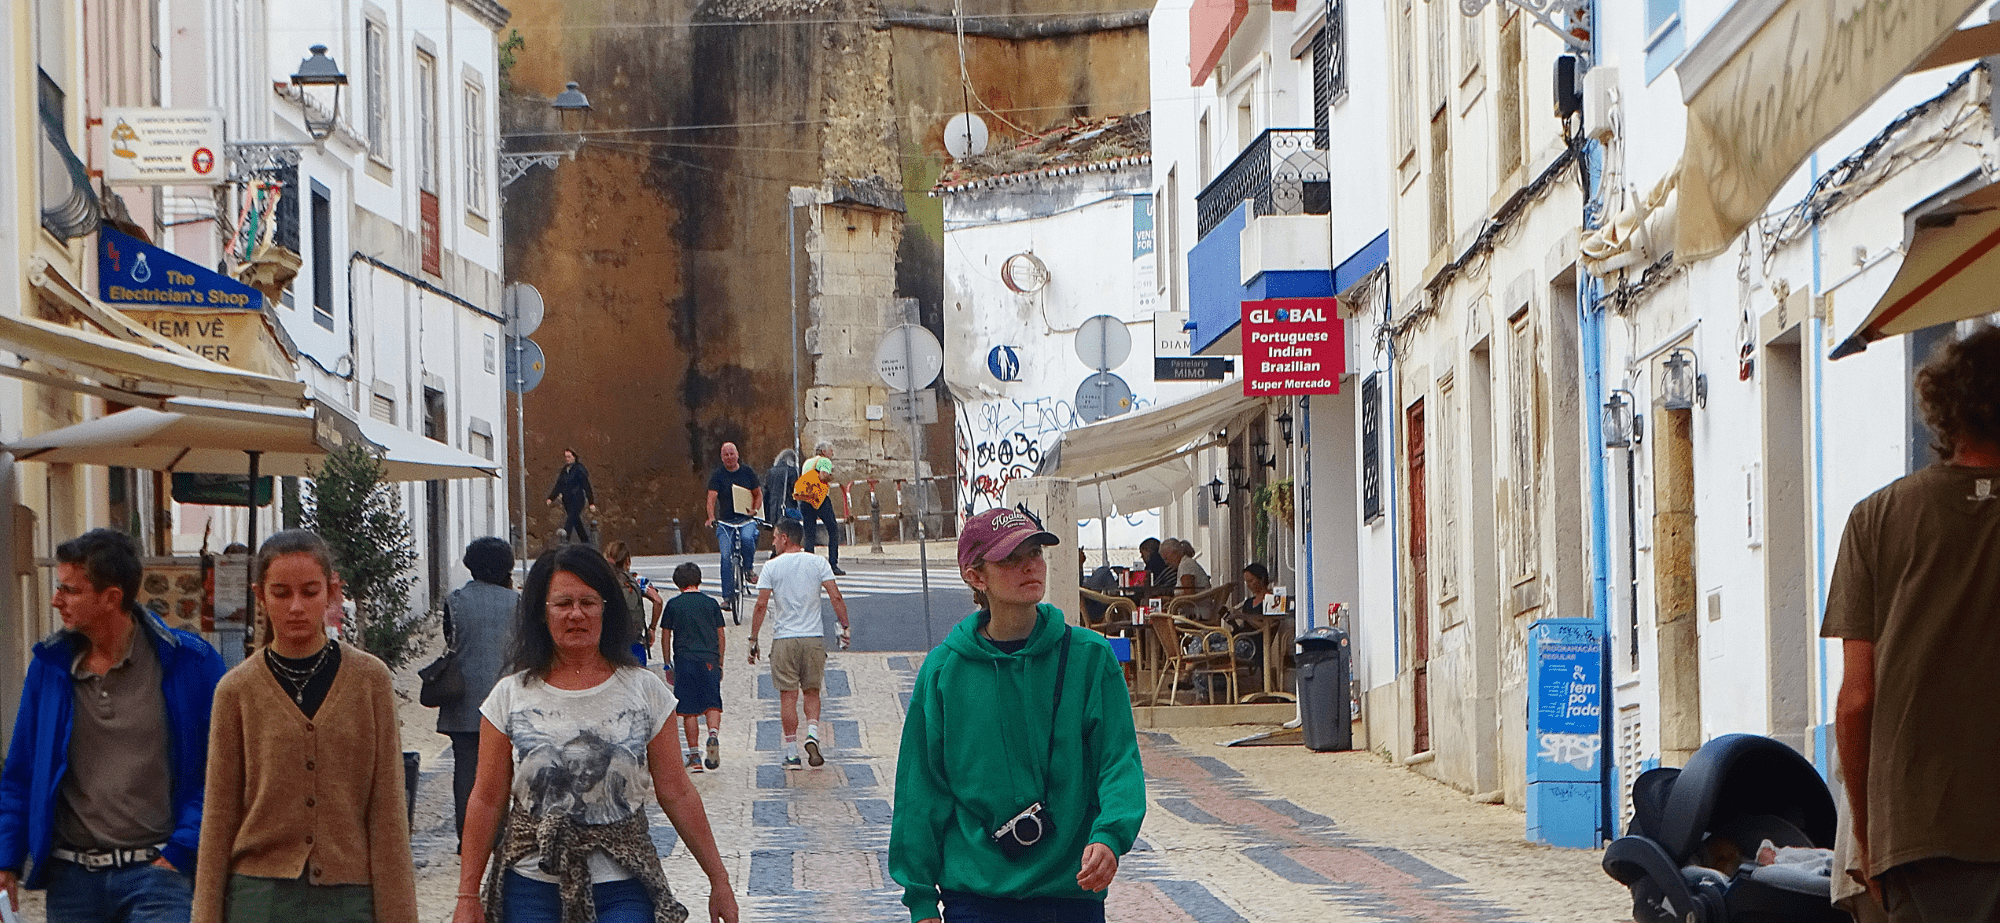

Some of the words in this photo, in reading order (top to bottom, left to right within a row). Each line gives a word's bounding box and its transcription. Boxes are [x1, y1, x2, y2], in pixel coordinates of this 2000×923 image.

[1137, 240, 1152, 250] FOR
[166, 270, 196, 286] The
[109, 285, 204, 303] Electrician's
[208, 289, 249, 306] Shop
[197, 317, 224, 338] VÊ
[1251, 331, 1328, 346] Portuguese
[1268, 346, 1312, 358] Indian
[1171, 360, 1208, 368] Pastelaria
[1261, 360, 1320, 373] Brazilian
[1174, 367, 1205, 378] MIMO
[1251, 379, 1282, 391] Super
[1284, 377, 1331, 389] Mercado
[1569, 681, 1596, 694] tem
[1567, 693, 1587, 707] po
[1566, 702, 1600, 718] rada
